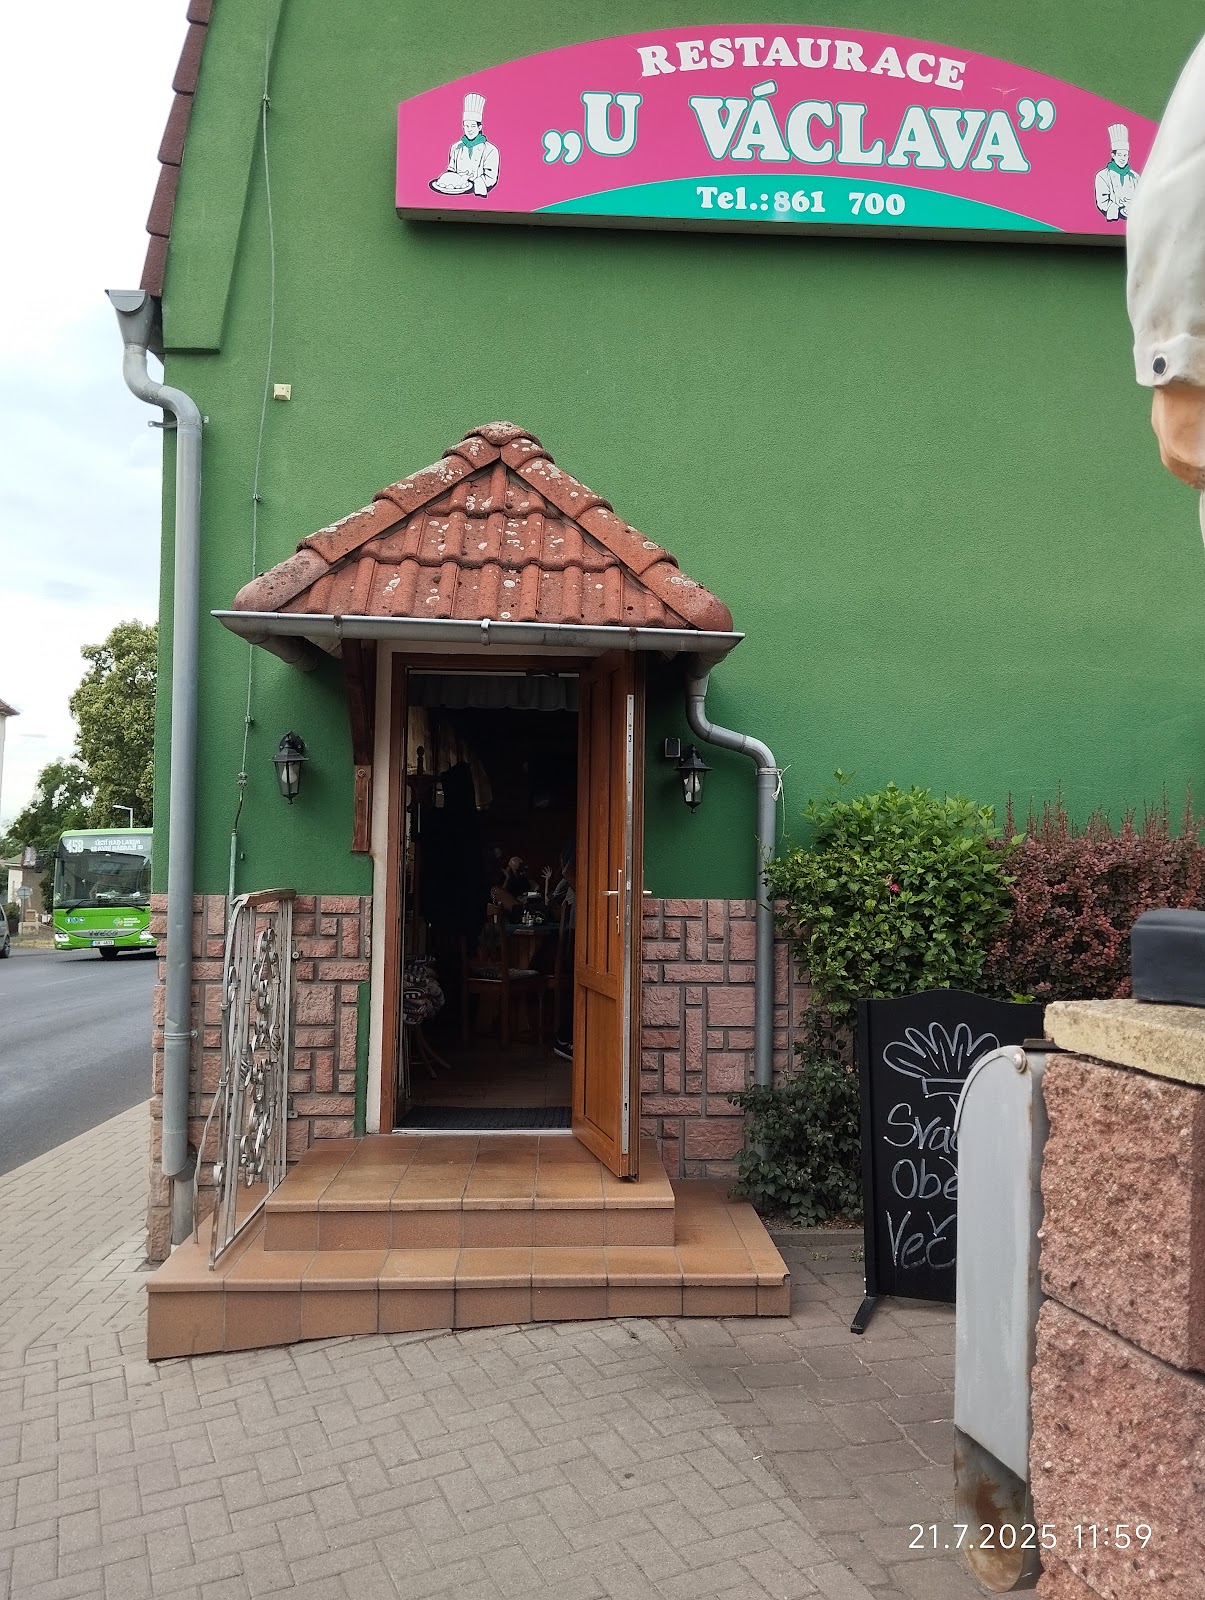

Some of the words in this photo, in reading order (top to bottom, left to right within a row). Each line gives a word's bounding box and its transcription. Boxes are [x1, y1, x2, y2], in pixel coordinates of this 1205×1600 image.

[637, 36, 967, 91] RESTAURACE
[773, 190, 826, 214] 861
[848, 192, 907, 216] 700
